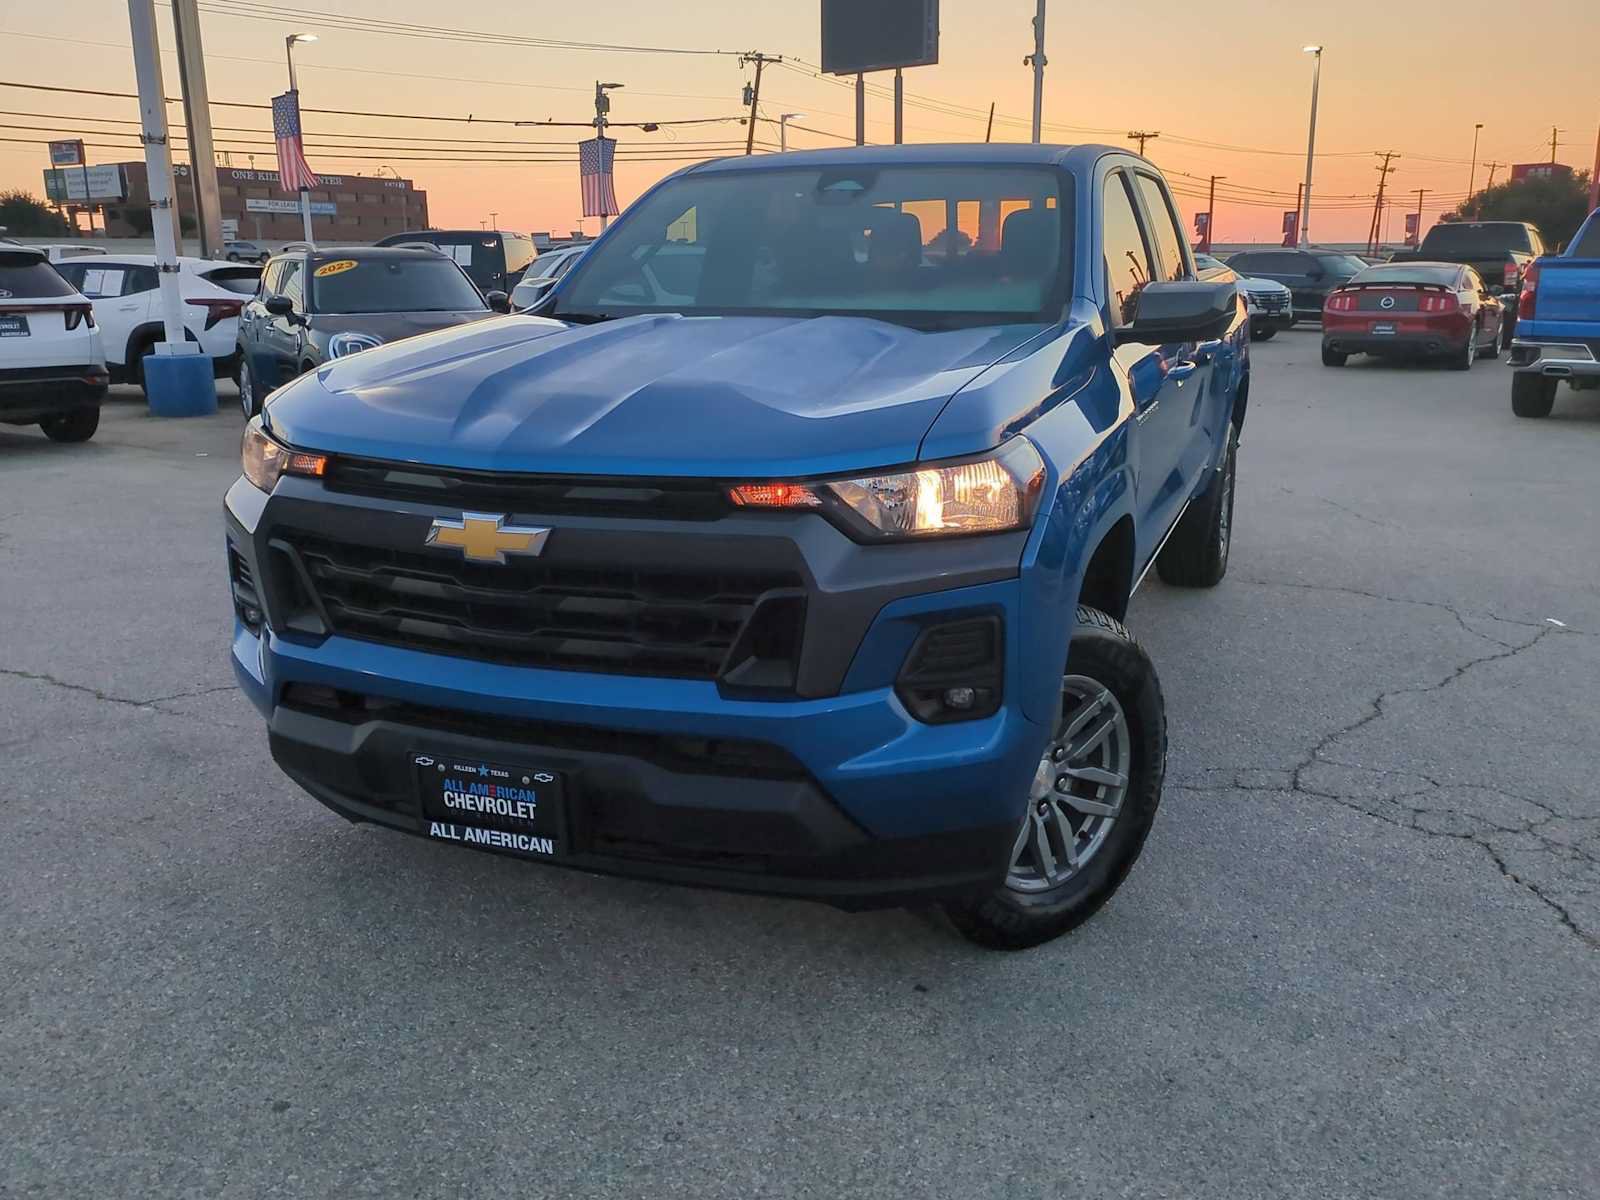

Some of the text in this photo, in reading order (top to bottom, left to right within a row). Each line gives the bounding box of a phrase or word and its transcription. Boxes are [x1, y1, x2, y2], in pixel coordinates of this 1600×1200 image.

[232, 170, 254, 180] ONE
[258, 172, 280, 182] KILL
[319, 261, 354, 276] 2023
[453, 764, 509, 778] KILLEEN TEXAS
[443, 778, 537, 803] ALL AMERICAN
[443, 790, 537, 820] CHEVROLET
[430, 822, 554, 855] ALL AMERICAN
